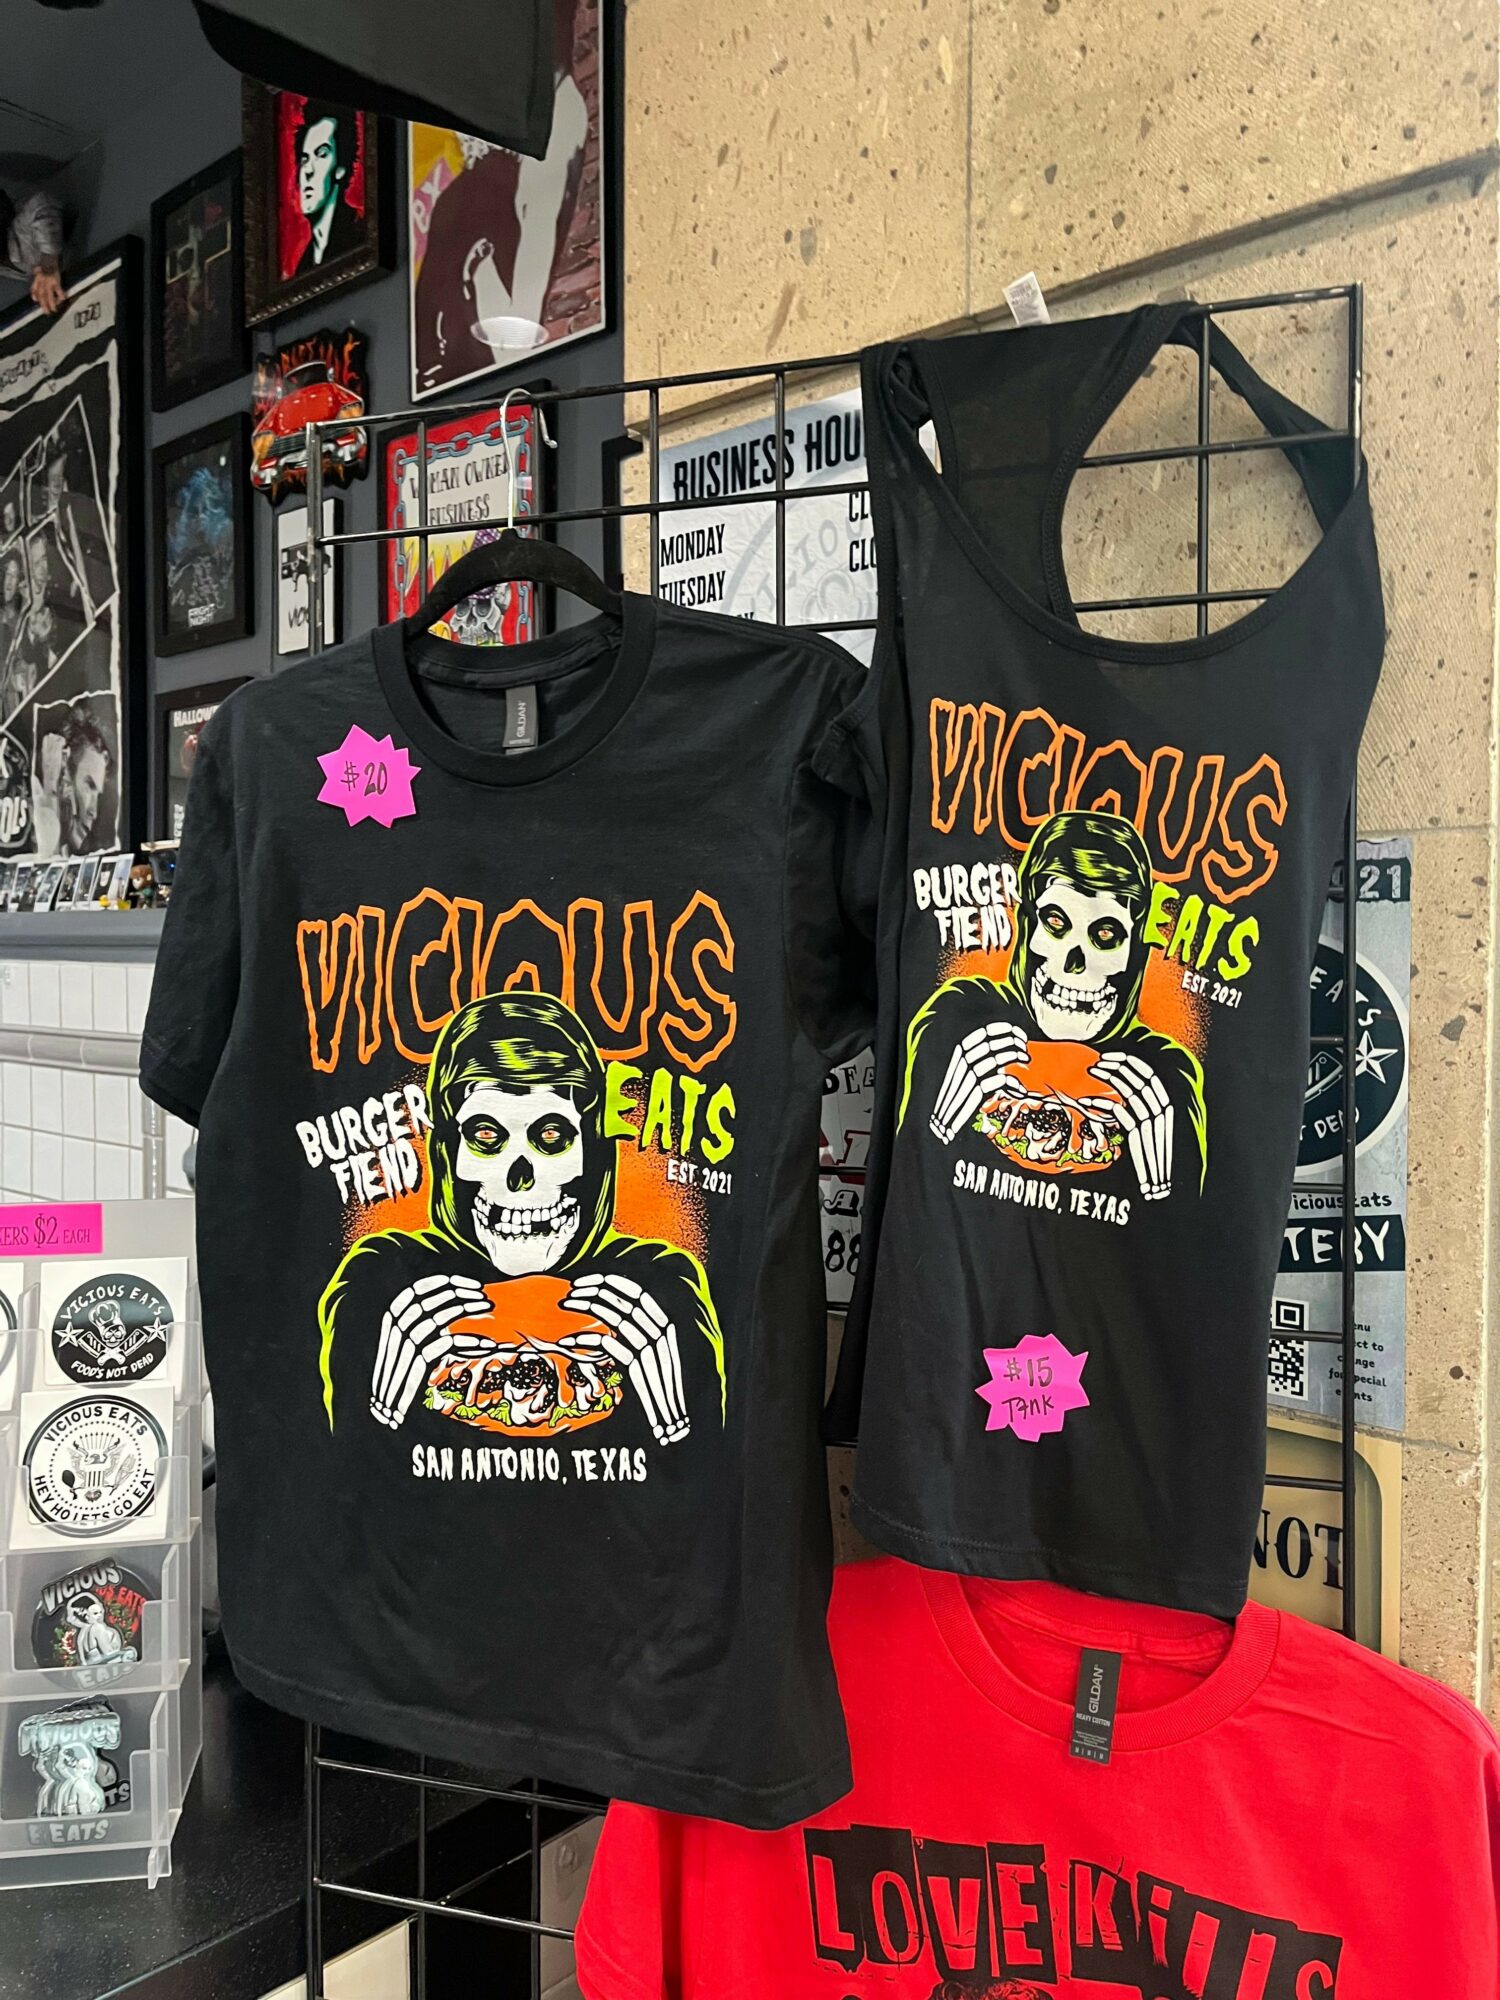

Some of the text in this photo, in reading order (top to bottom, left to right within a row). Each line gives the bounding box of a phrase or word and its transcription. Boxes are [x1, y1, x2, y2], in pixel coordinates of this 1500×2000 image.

[673, 409, 862, 501] BUSINESS HOU
[409, 466, 460, 499] WMAN
[660, 524, 725, 567] MONDAY
[660, 571, 726, 607] TUESDAY
[173, 704, 220, 728] HALLOW
[929, 697, 1288, 905] VICIOUS
[913, 862, 1022, 911] BURGER
[934, 902, 1012, 951] FIEND
[1143, 881, 1259, 981] EATS
[296, 886, 738, 1074] VICIOUS
[1181, 970, 1242, 1009] EST. 2021
[295, 1083, 434, 1169] BURGER
[603, 1060, 737, 1164] EATS
[330, 1138, 423, 1205] FIEND
[667, 1158, 732, 1195] EST. 2021
[953, 1159, 1131, 1226] SAN ANTONIO, TEXAS
[0, 1213, 91, 1249] ERS $2 EACH
[1283, 1220, 1390, 1265] TERY
[60, 1284, 166, 1320] VICIOUS EATS
[71, 1352, 155, 1379] FOOD'S NOT DEAD
[1337, 1355, 1375, 1368] cnge
[1371, 1342, 1384, 1352] to
[1335, 1388, 1373, 1402] ents
[1354, 1374, 1387, 1387] pecial
[44, 1406, 148, 1442] VICIOUS EATS
[412, 1443, 647, 1485] SAN ANTONIO, TEXAS
[34, 1475, 55, 1505] HEY
[50, 1503, 71, 1520] HO
[113, 1499, 133, 1516] GO
[132, 1468, 155, 1499] EAT
[43, 1562, 120, 1613] VICIOUS
[1088, 1666, 1104, 1714] GILDAN
[49, 1819, 109, 1844] EATS
[811, 1853, 1043, 1971] LOVE
